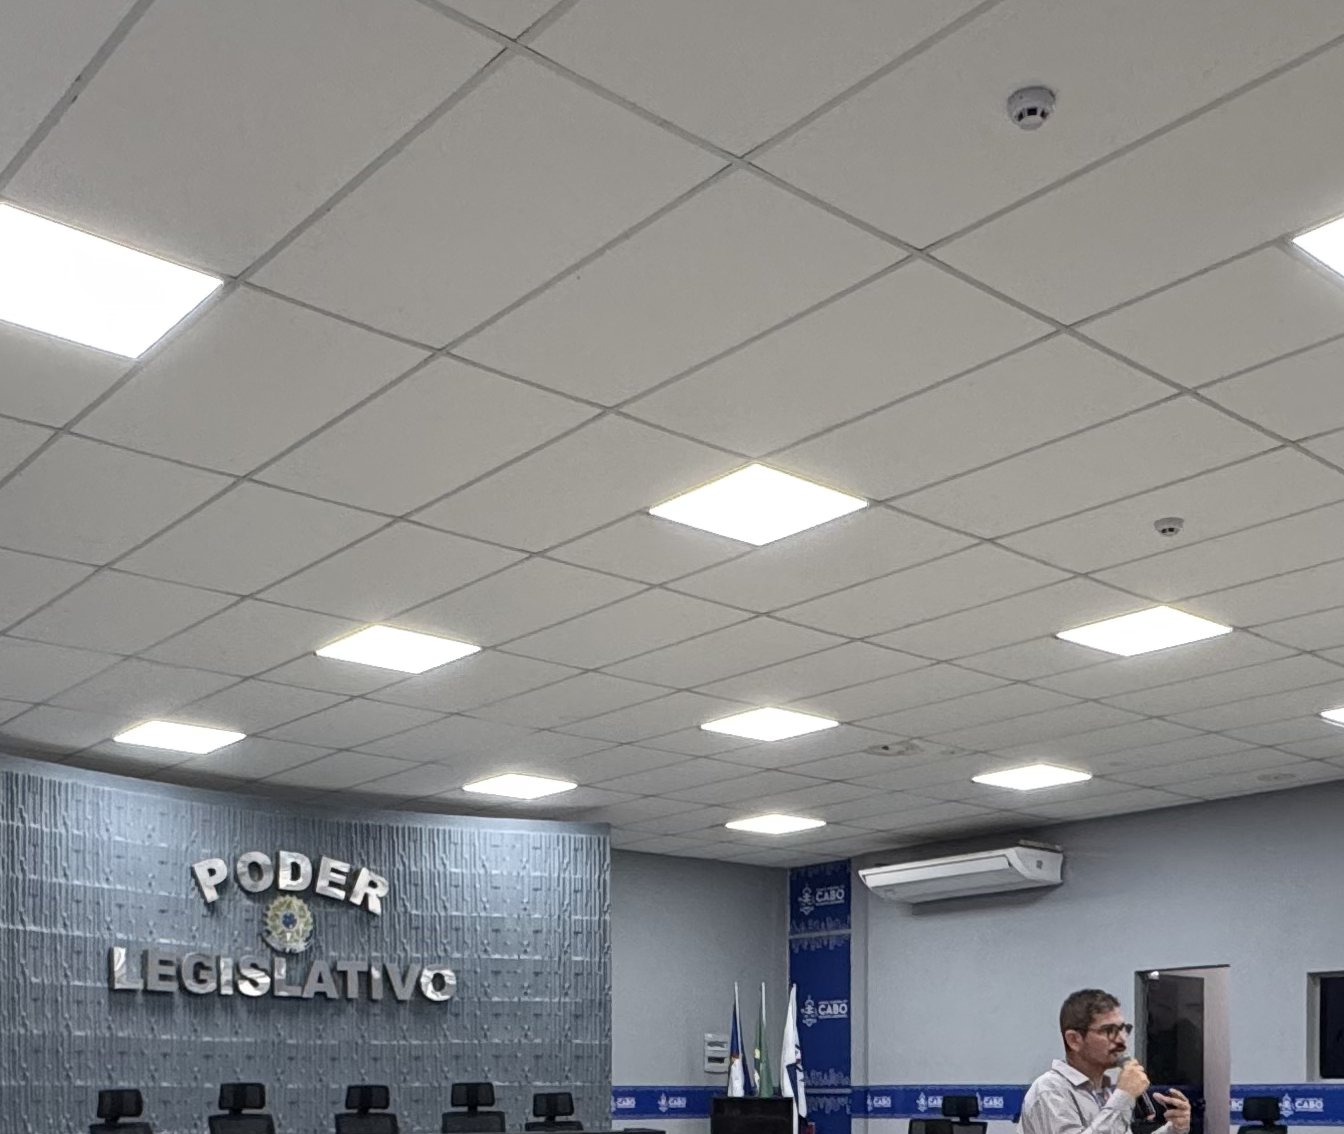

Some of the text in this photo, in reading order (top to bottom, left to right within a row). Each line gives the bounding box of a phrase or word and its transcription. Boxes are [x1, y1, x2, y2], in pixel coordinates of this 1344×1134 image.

[191, 850, 389, 915] PODER
[816, 889, 845, 902] CABO
[109, 946, 456, 1002] LEGISLATIVO
[818, 1003, 848, 1016] CABO
[1294, 1100, 1324, 1110] CABO
